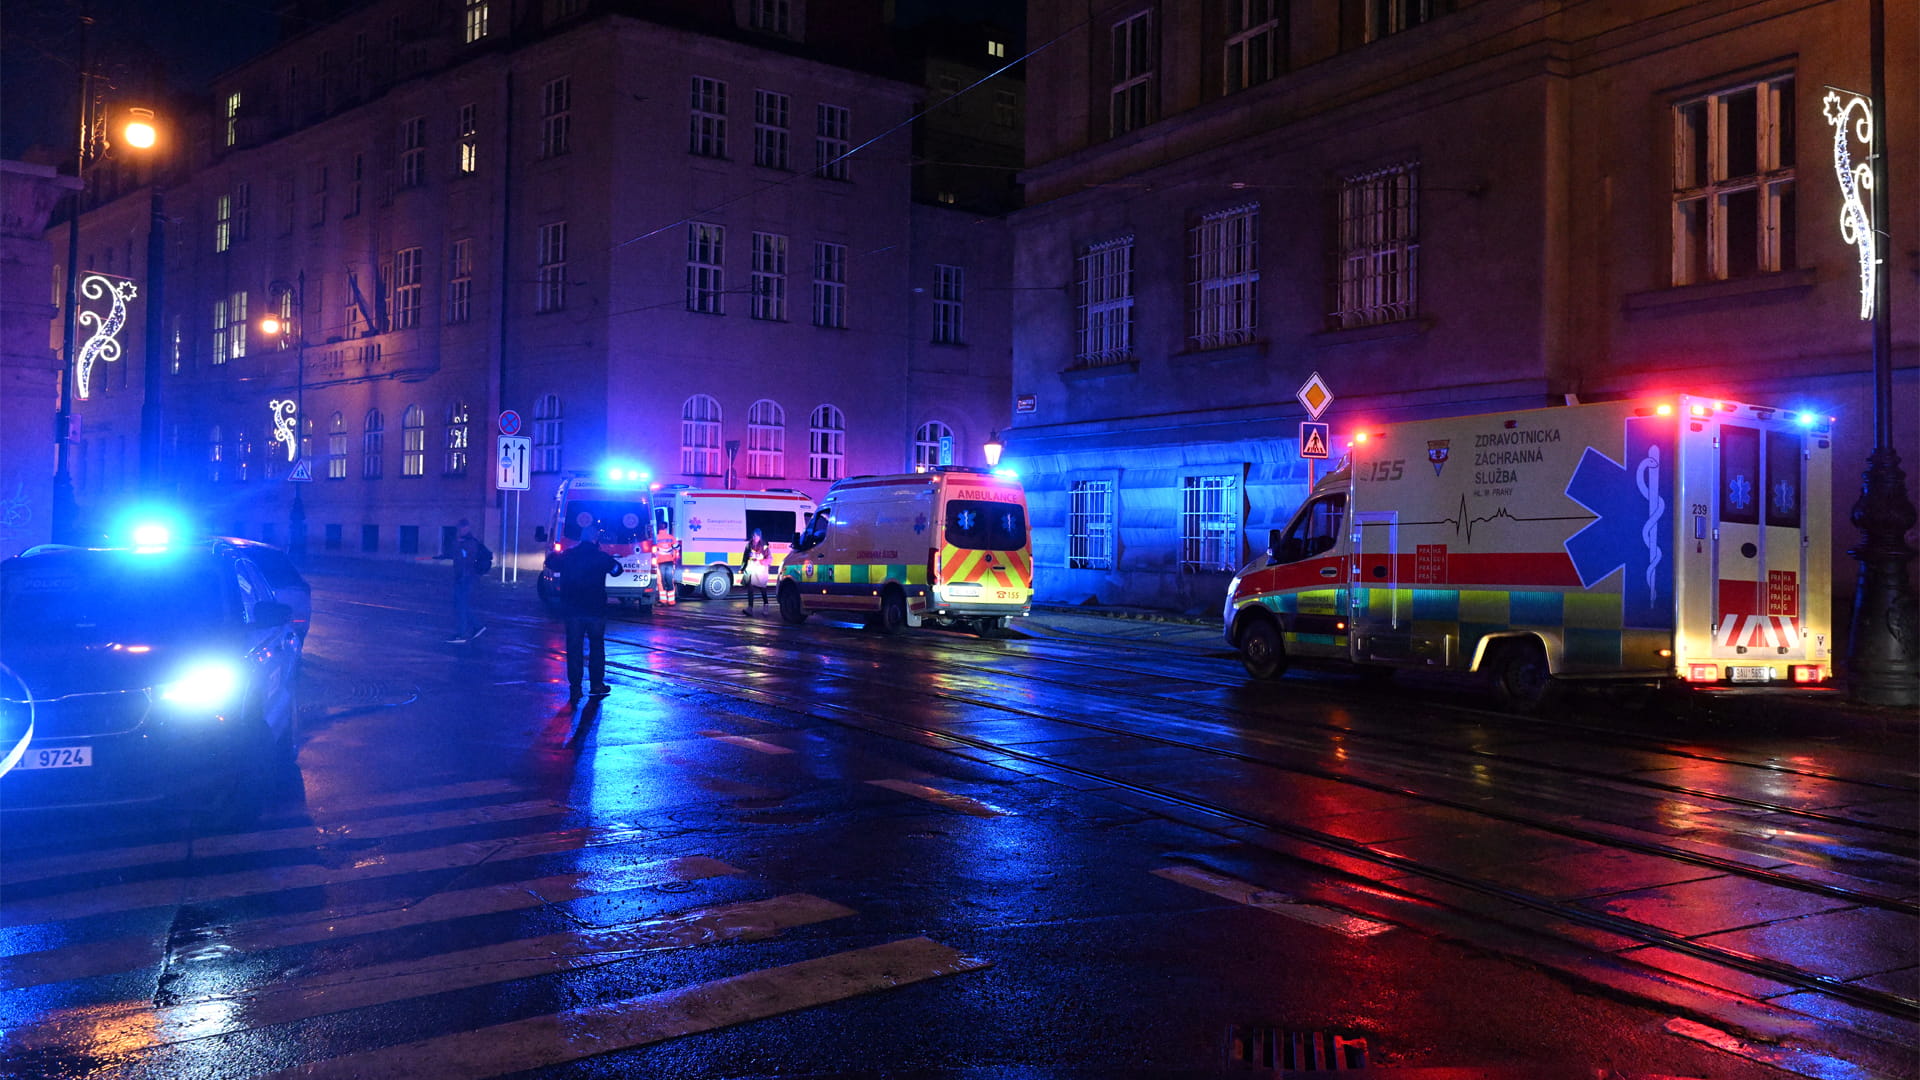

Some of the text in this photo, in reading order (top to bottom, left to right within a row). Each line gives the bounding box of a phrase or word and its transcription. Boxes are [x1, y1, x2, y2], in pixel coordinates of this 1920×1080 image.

[942, 440, 950, 457] P
[1370, 460, 1405, 482] 155
[1475, 468, 1518, 484] SLUŽBA
[958, 489, 1017, 503] AMBULANCE
[1692, 504, 1707, 515] 239
[1008, 591, 1020, 599] 155
[39, 749, 84, 767] 9724
